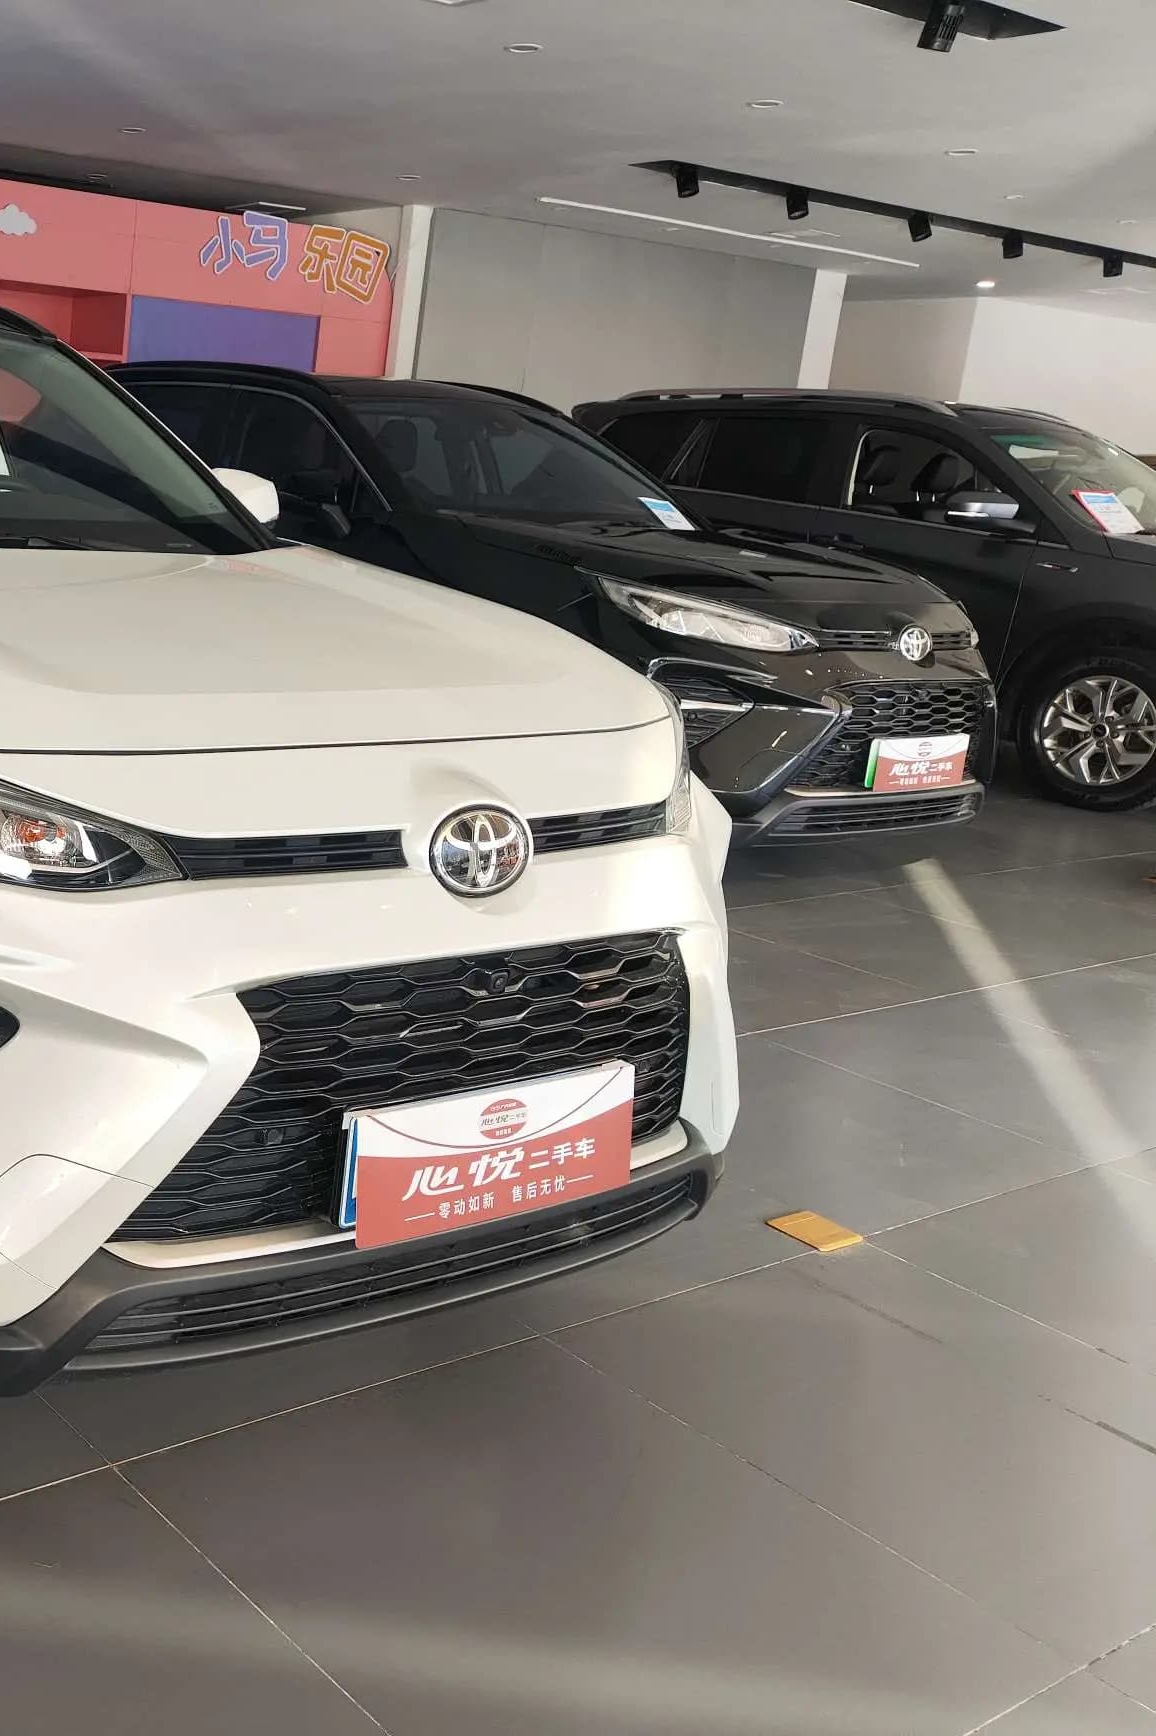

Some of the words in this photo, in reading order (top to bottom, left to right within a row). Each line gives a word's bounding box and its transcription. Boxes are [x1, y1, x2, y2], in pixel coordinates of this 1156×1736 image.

[200, 210, 390, 304] 小马乐园
[402, 1138, 596, 1201] 心悦二手车
[438, 1191, 495, 1219] 零动如新
[511, 1175, 565, 1203] 售后无忧
